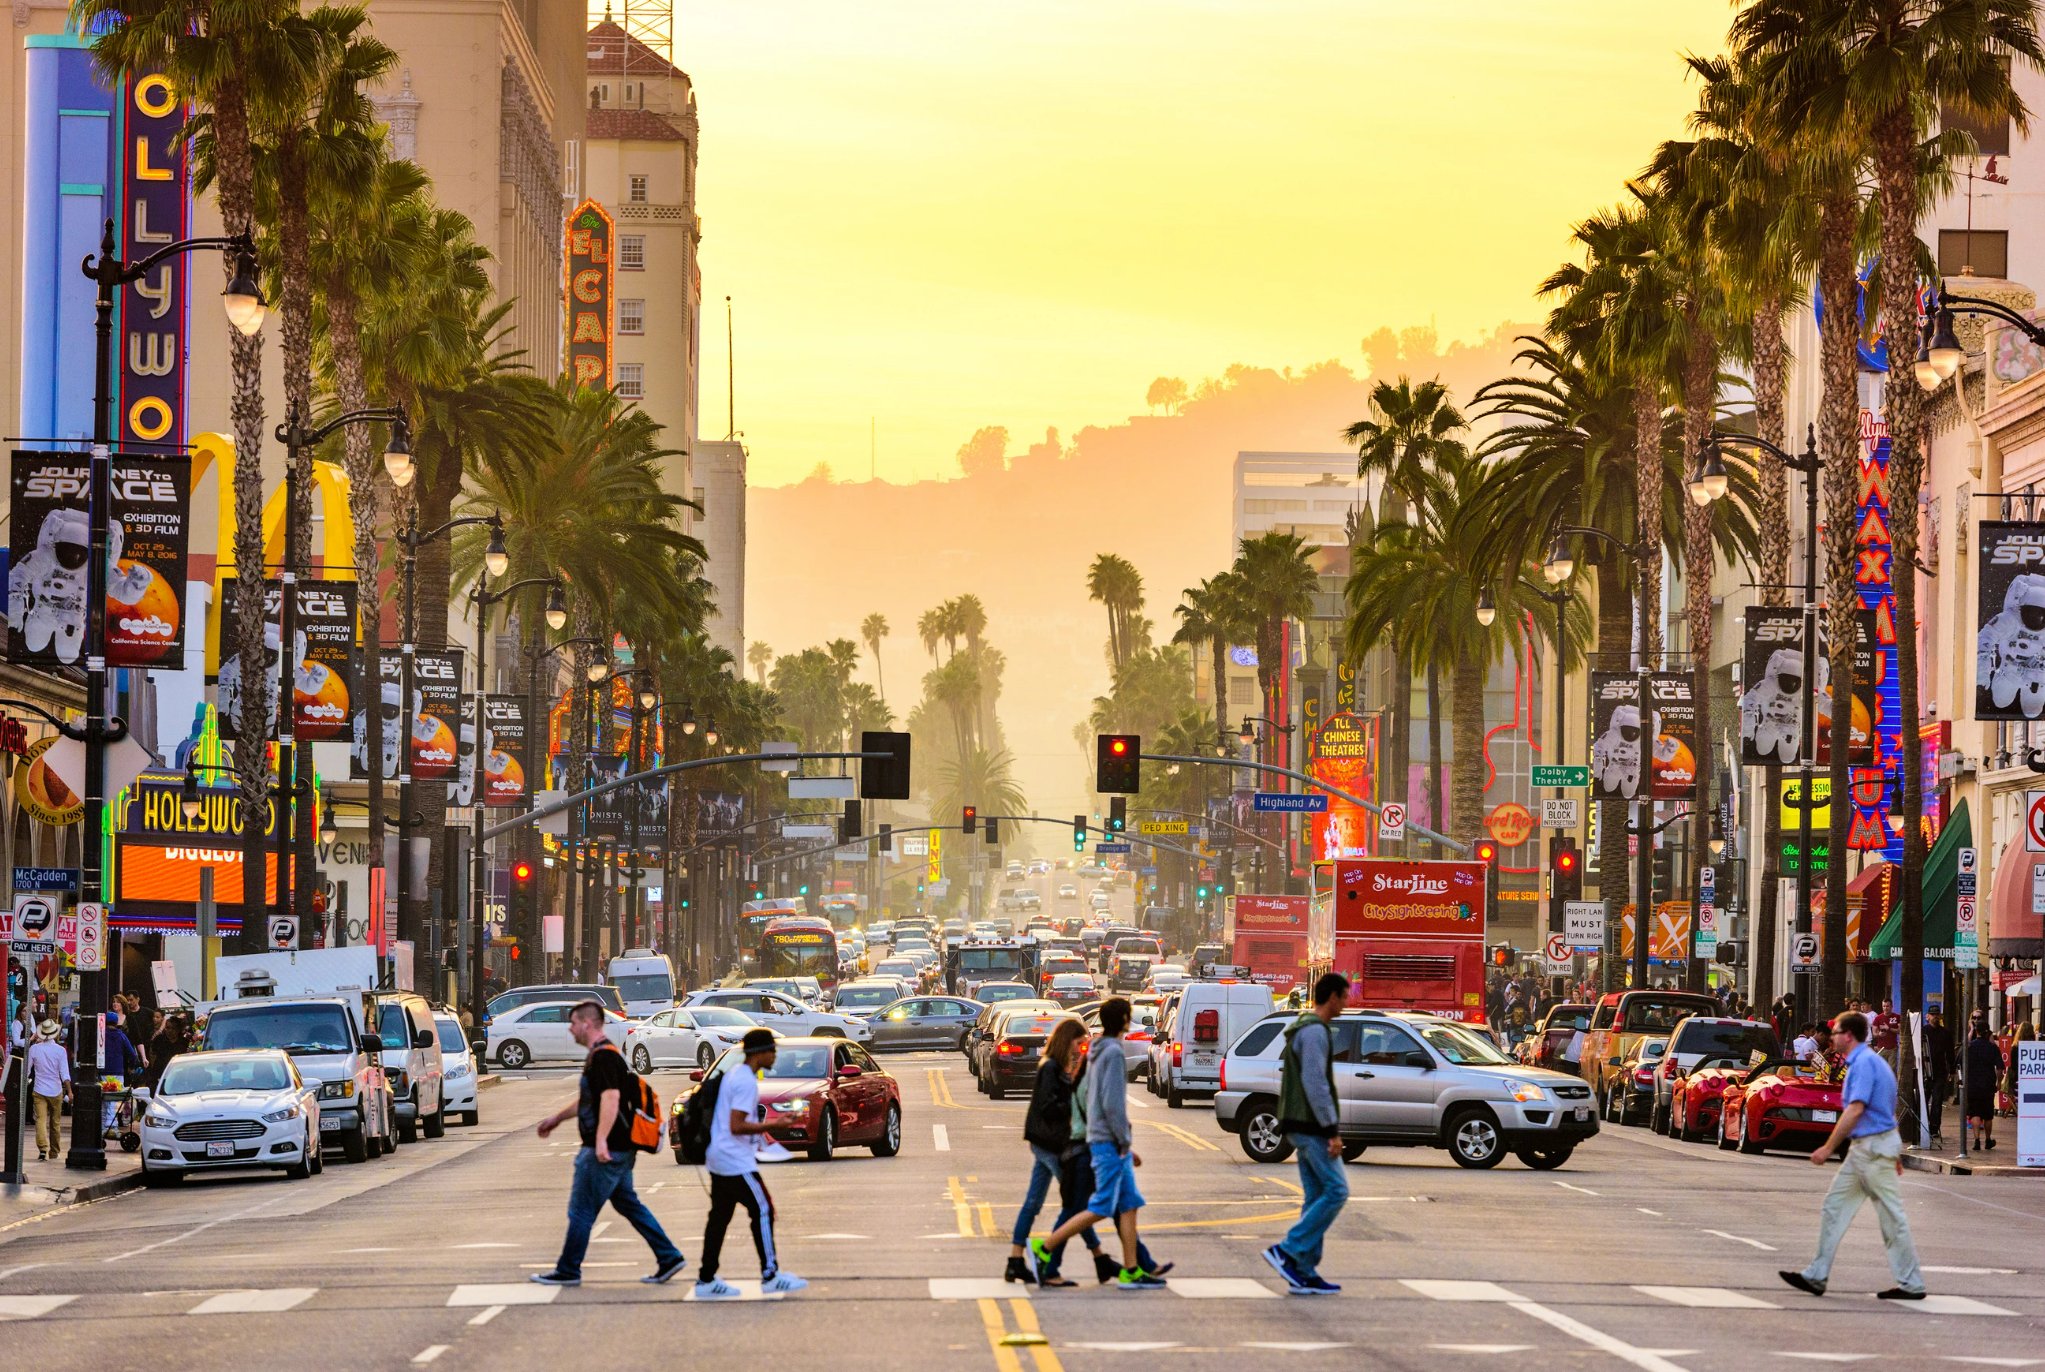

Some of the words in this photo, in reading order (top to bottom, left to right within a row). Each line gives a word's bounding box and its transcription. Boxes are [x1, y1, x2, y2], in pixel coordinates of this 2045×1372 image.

[580, 214, 600, 229] The
[572, 229, 608, 263] EL
[123, 513, 181, 524] EXHIBITION
[1856, 459, 1891, 584] WAX
[125, 523, 132, 533] &
[135, 524, 152, 533] 3D
[154, 525, 179, 535] FILM
[1996, 535, 2045, 545] JOU
[127, 550, 145, 558] MAY
[157, 551, 178, 560] 2016
[1990, 546, 2045, 565] SP
[306, 624, 350, 633] EXHIBITION
[140, 638, 161, 646] Science
[329, 634, 349, 642] FILM
[1323, 730, 1361, 743] CHINESE
[1320, 744, 1364, 757] THEATRES
[1540, 767, 1567, 778] Dolby
[1535, 776, 1572, 785] Theatre
[1259, 797, 1304, 810] Highland
[1308, 798, 1322, 808] Av
[1546, 801, 1557, 810] DO
[1559, 801, 1573, 810] NOT
[28, 803, 57, 823] Since
[61, 806, 86, 823] 1989
[1548, 810, 1571, 820] BLOCK
[1143, 823, 1161, 833] PED
[1164, 823, 1185, 833] XING
[1381, 829, 1390, 837] ON
[1390, 830, 1402, 838] RED
[930, 834, 939, 876] INN
[15, 869, 67, 882] McCadden
[15, 880, 32, 889] 1700
[34, 880, 41, 889] N
[69, 881, 76, 890] Pl
[1567, 908, 1587, 916] RIGHT
[1588, 908, 1603, 916] LAN
[59, 917, 77, 933] AT
[1571, 920, 1602, 929] MUST
[773, 935, 790, 944] 780
[13, 943, 29, 952] PAY
[30, 943, 53, 954] HERE
[1548, 963, 1557, 972] ON
[1559, 964, 1572, 972] RED
[2020, 1048, 2045, 1061] PUB
[2019, 1063, 2045, 1076] PARK
